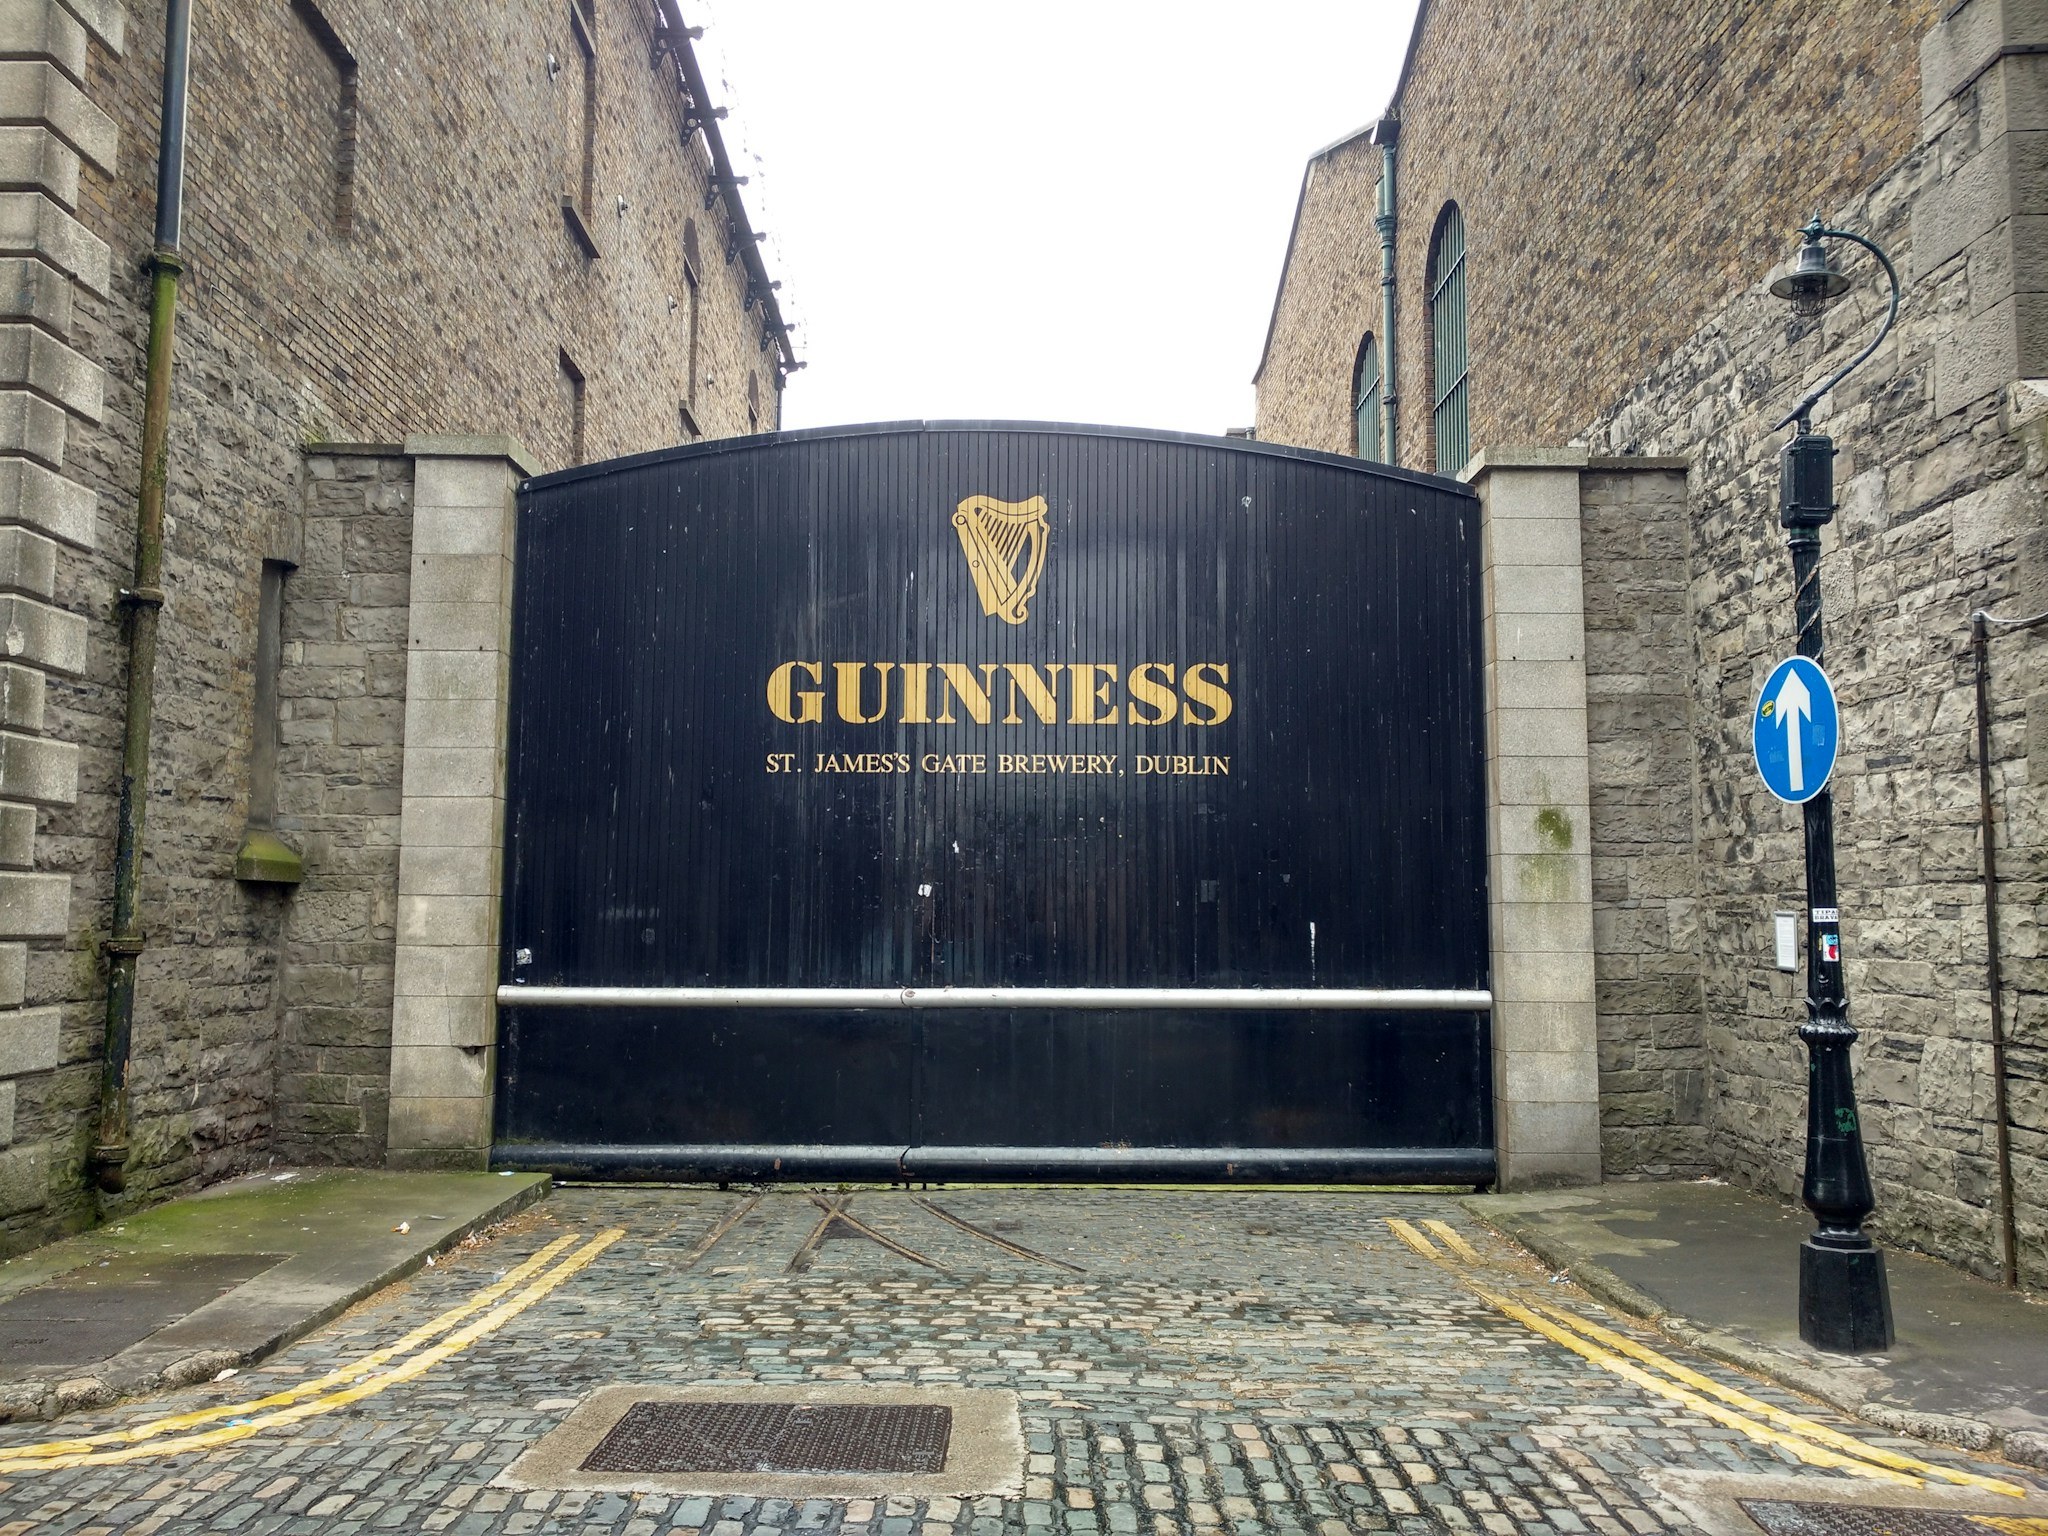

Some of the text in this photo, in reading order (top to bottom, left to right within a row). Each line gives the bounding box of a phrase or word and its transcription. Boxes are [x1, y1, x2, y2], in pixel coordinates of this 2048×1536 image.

[766, 661, 1233, 726] GUINNESS
[766, 752, 1231, 778] ST. JAMES'S GATE BREWERY, DUBLIN
